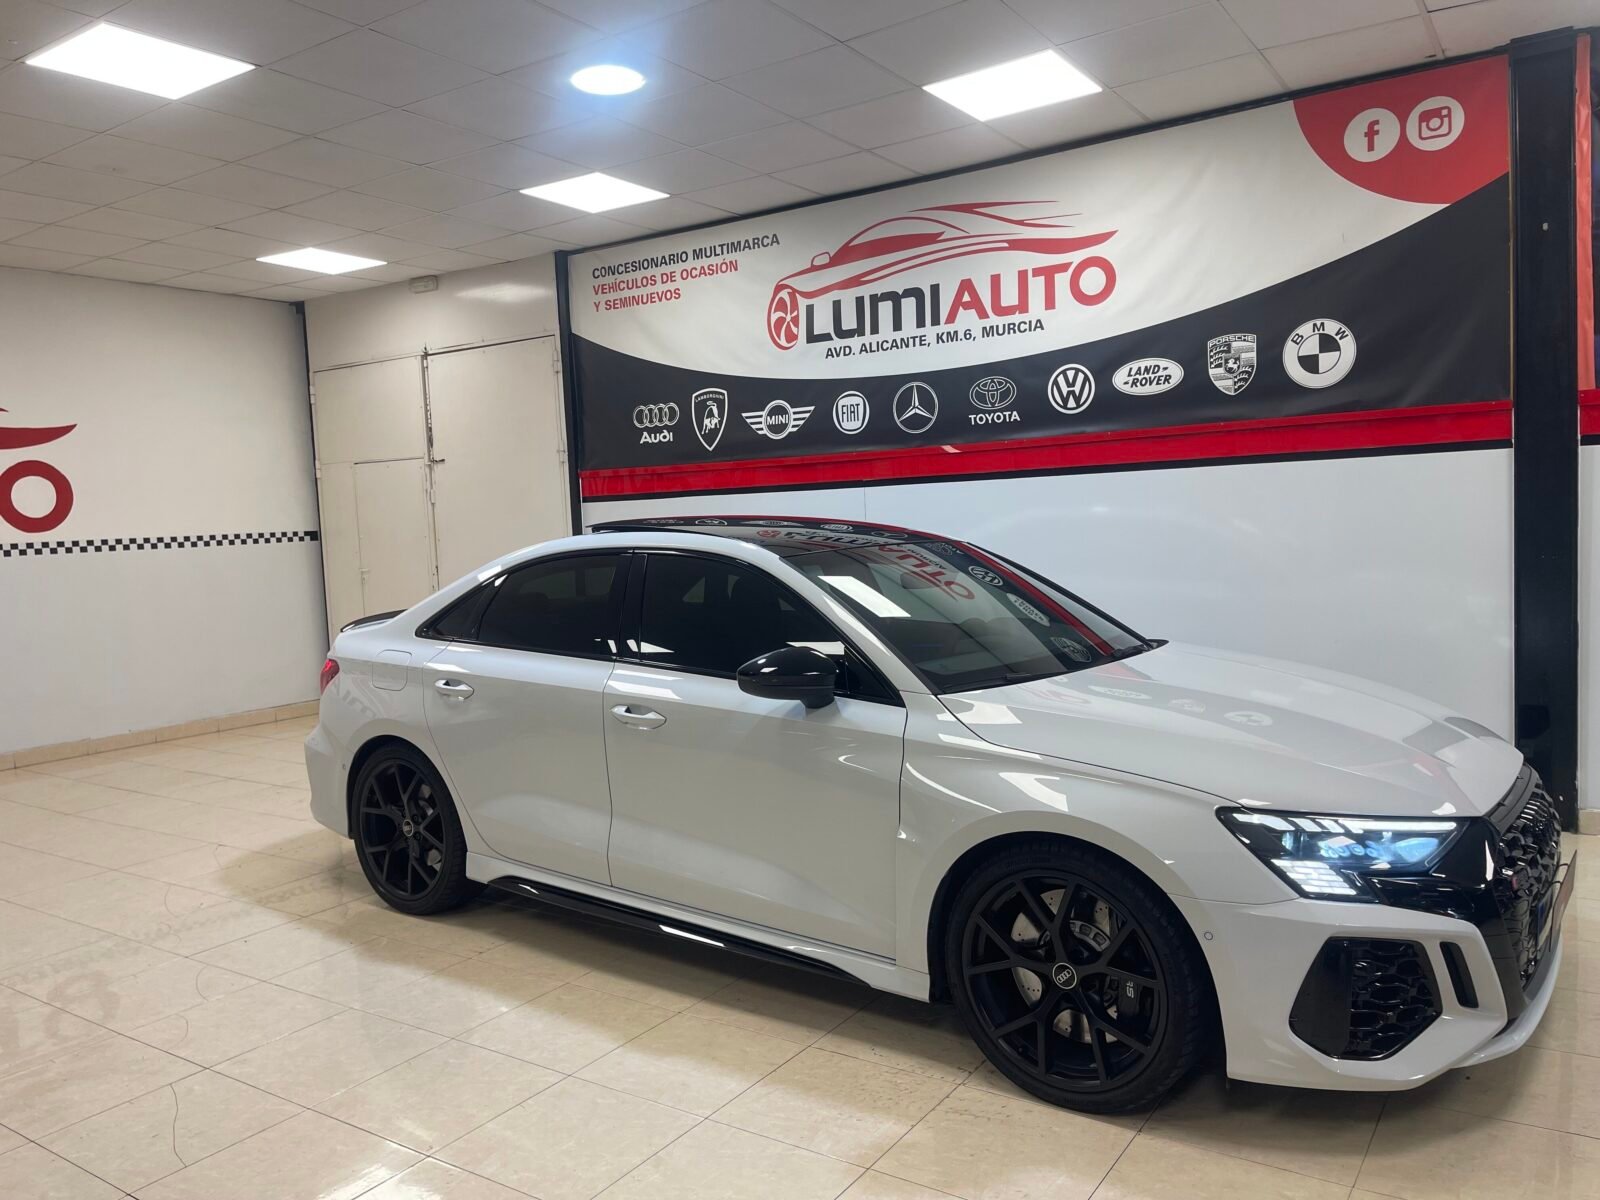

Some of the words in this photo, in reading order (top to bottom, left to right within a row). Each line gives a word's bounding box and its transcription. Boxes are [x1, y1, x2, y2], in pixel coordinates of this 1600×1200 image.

[592, 250, 689, 280] CONCESIONARIO
[692, 233, 780, 261] MULTIMARCA
[592, 274, 657, 296] VEHÍCULOS
[661, 270, 677, 285] DE
[680, 259, 739, 281] OCASIÓN
[593, 300, 601, 312] Y
[604, 287, 681, 311] SEMINUEVOS
[825, 343, 856, 360] AVD.
[858, 334, 932, 356] ALICANTE,
[935, 328, 977, 345] KM.6,
[981, 318, 1044, 339] MURCIA
[1209, 334, 1256, 348] PORSCHE
[1291, 321, 1349, 345] BMW
[766, 413, 789, 426] MINI
[841, 404, 861, 423] FIAT
[969, 410, 1021, 426] TOYOTA
